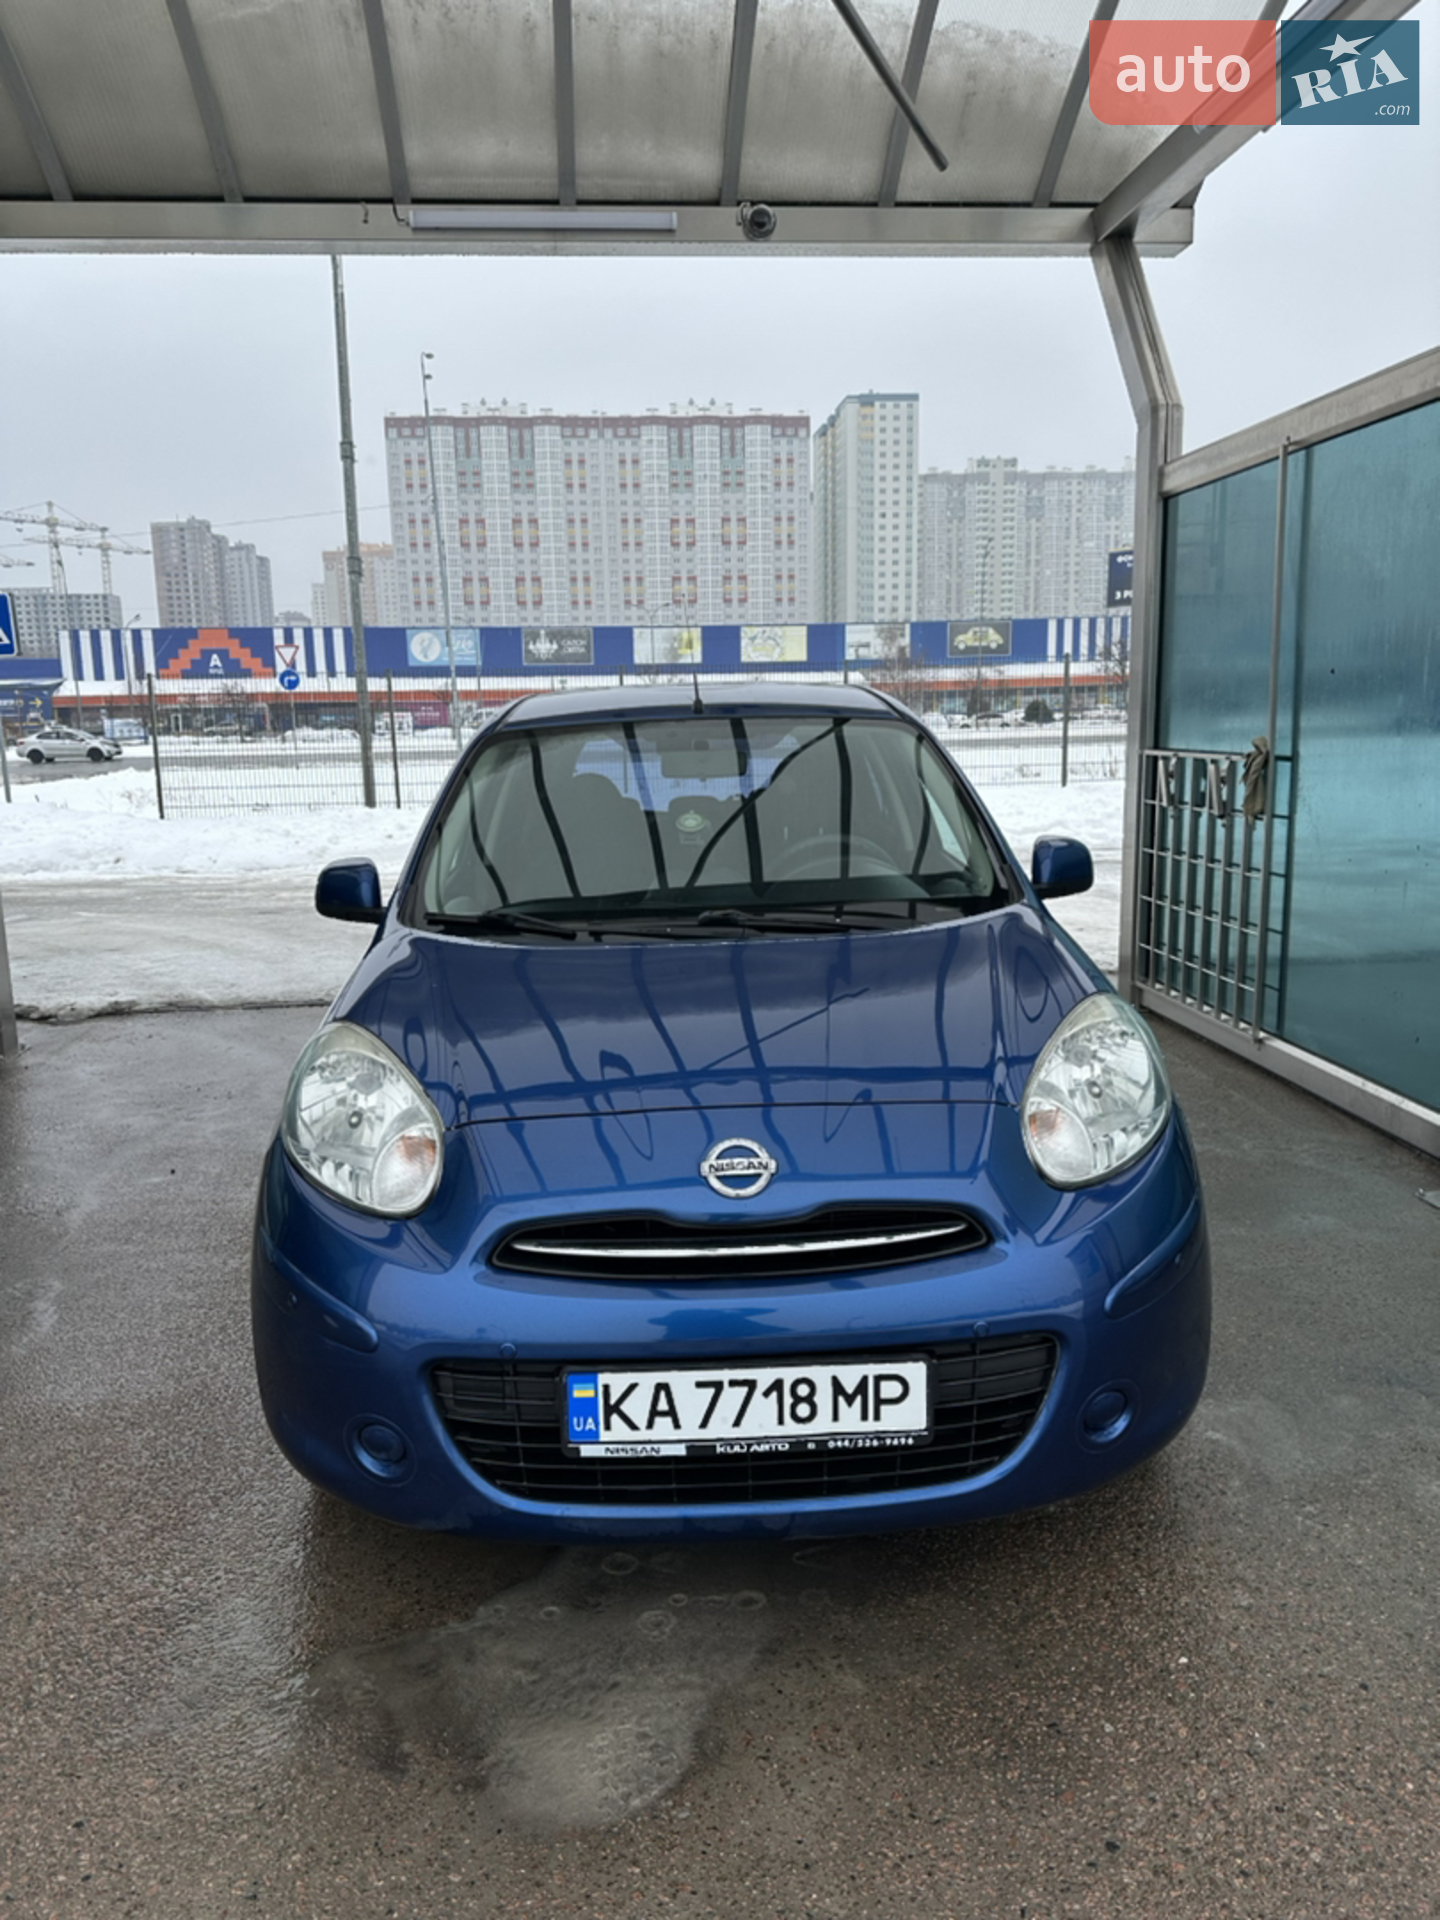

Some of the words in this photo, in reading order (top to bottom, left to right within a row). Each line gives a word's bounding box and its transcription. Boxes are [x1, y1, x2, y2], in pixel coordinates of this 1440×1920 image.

[709, 1160, 769, 1173] NISSAN
[602, 1381, 682, 1431] KA
[695, 1377, 818, 1429] 7718
[831, 1373, 910, 1422] MP
[573, 1416, 596, 1431] UA
[604, 1446, 660, 1455] NISSAN
